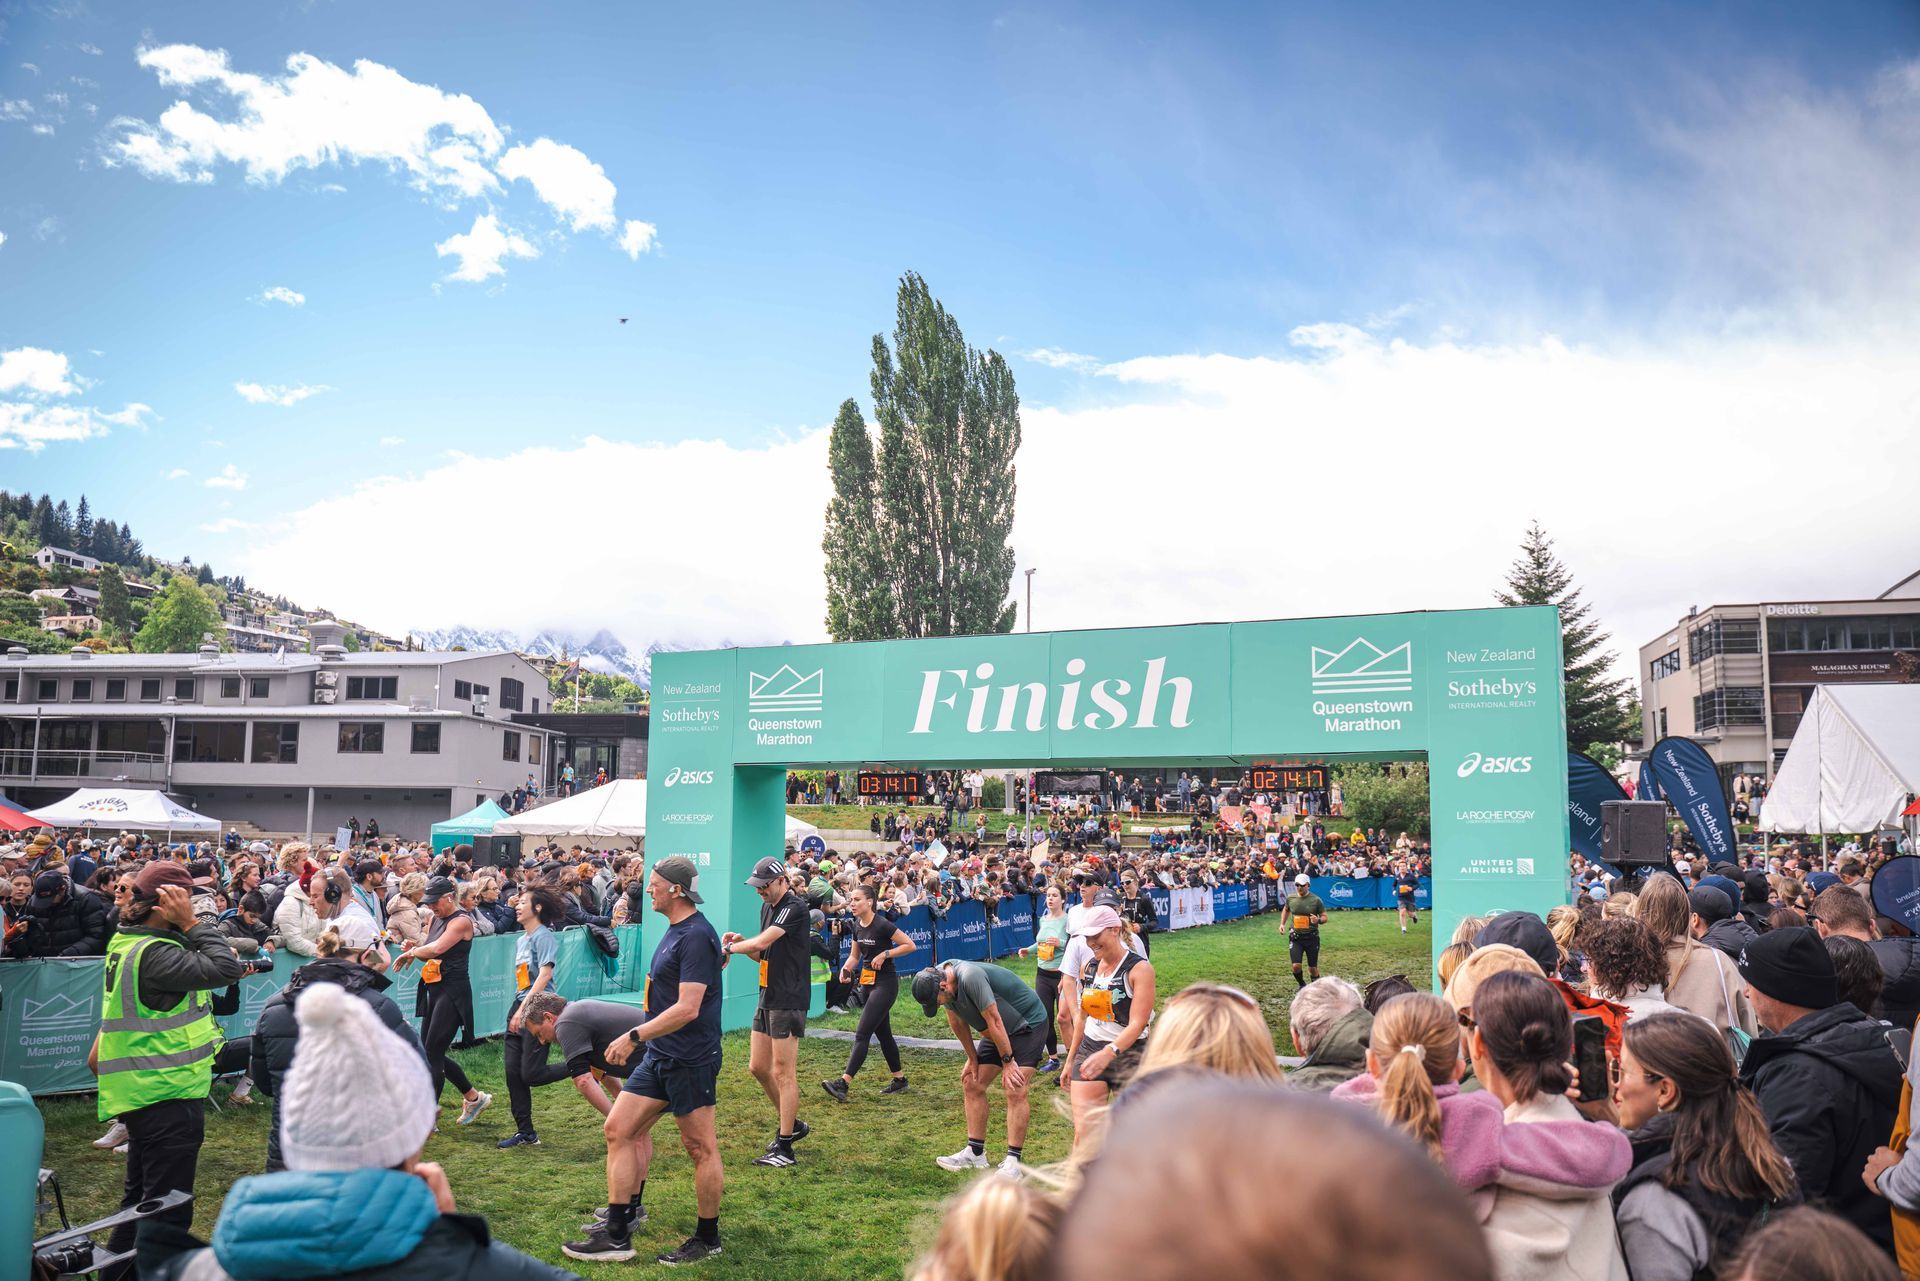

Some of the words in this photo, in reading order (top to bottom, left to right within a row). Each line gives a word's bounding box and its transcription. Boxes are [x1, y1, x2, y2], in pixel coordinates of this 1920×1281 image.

[1766, 604, 1818, 615] Deloitte
[1447, 650, 1476, 663] New
[1480, 648, 1535, 661] Zealand
[663, 685, 682, 695] New
[685, 682, 721, 694] Zealand
[906, 656, 1194, 734] Finish
[1448, 678, 1536, 698] Sotheby's
[1312, 700, 1413, 715] Queenstown
[662, 707, 720, 724] Sotheby's
[748, 718, 822, 731] Queenstown
[1325, 717, 1400, 732] Marathon
[757, 733, 812, 745] Marathon
[1254, 769, 1323, 789] 02:14:17
[1664, 749, 1678, 766] New
[1675, 765, 1698, 797] Zealand
[860, 777, 917, 793] 03:14:17
[1568, 800, 1597, 826] aland
[1697, 802, 1728, 854] Sotheby's
[20, 1033, 90, 1046] Queenstown
[27, 1045, 80, 1056] Marathon
